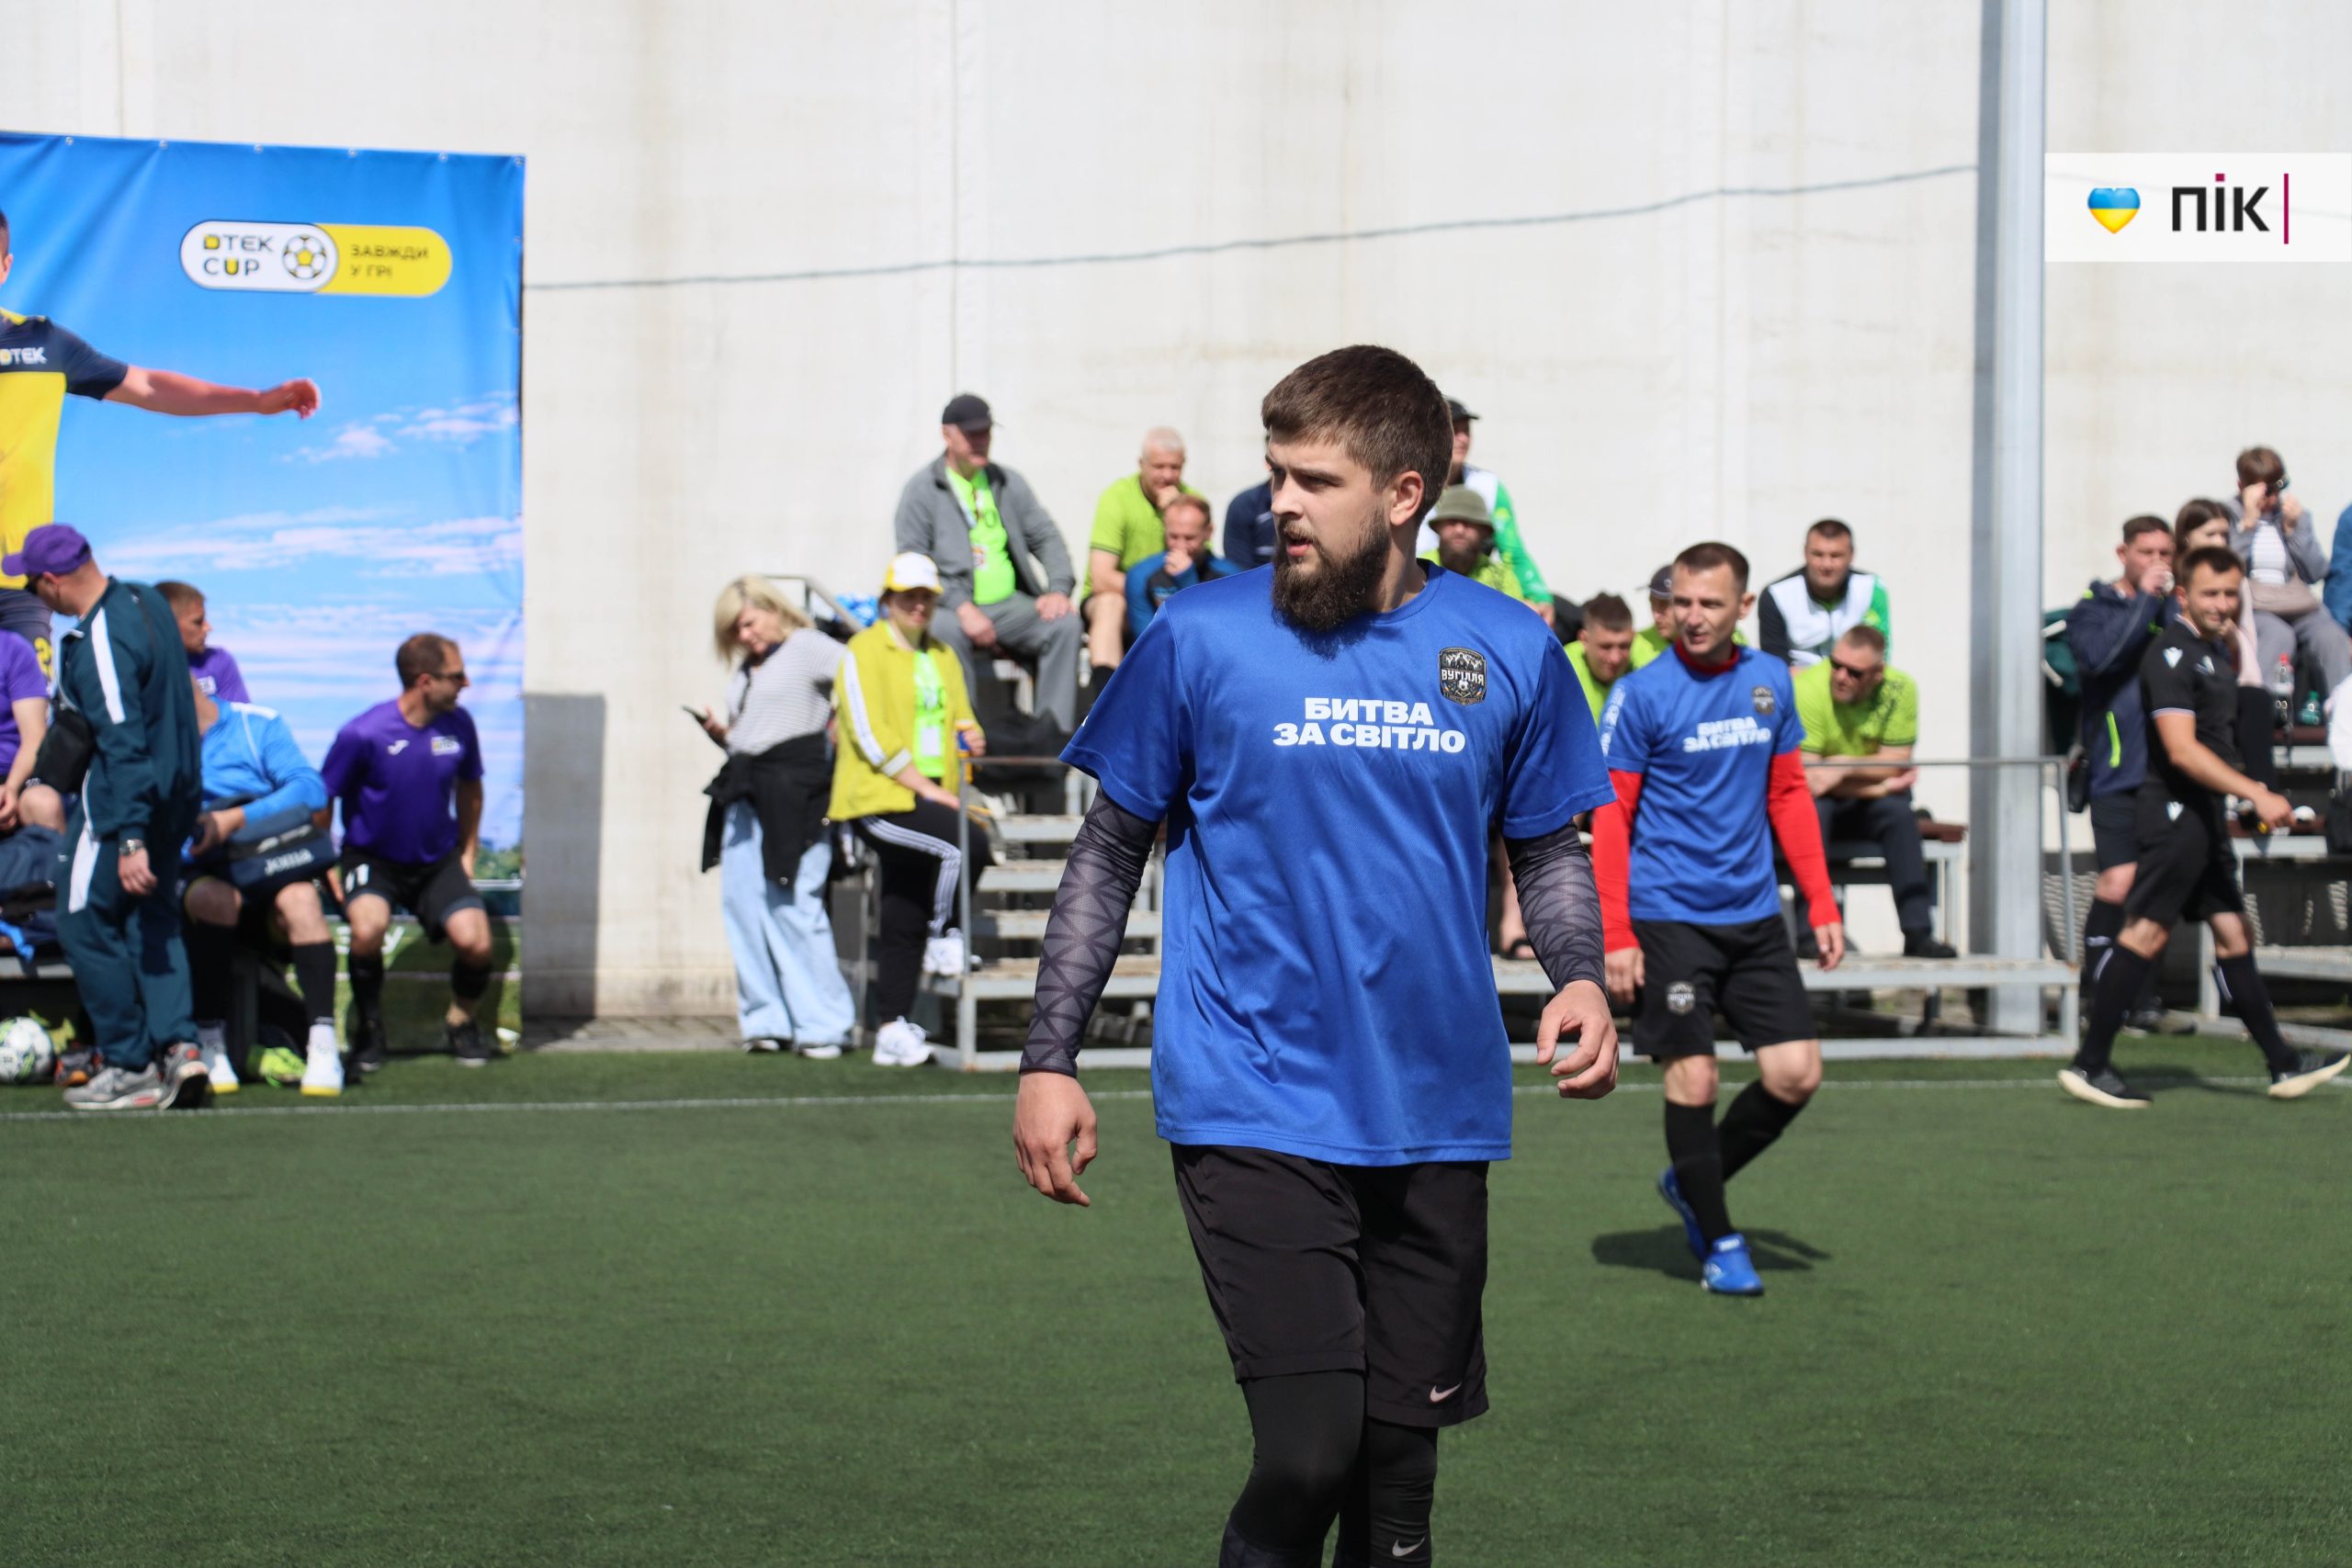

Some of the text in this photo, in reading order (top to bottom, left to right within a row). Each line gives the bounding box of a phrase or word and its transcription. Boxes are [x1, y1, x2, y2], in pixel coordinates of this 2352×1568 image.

[203, 234, 274, 253] DTEK
[351, 244, 430, 261] ЗАВЖДИ
[204, 256, 260, 276] CUP
[351, 265, 360, 276] У
[1441, 669, 1485, 686] ВУГІЛЛЯ
[1305, 697, 1434, 726] БИТВА
[1272, 722, 1466, 753] ЗА СВІТЛО
